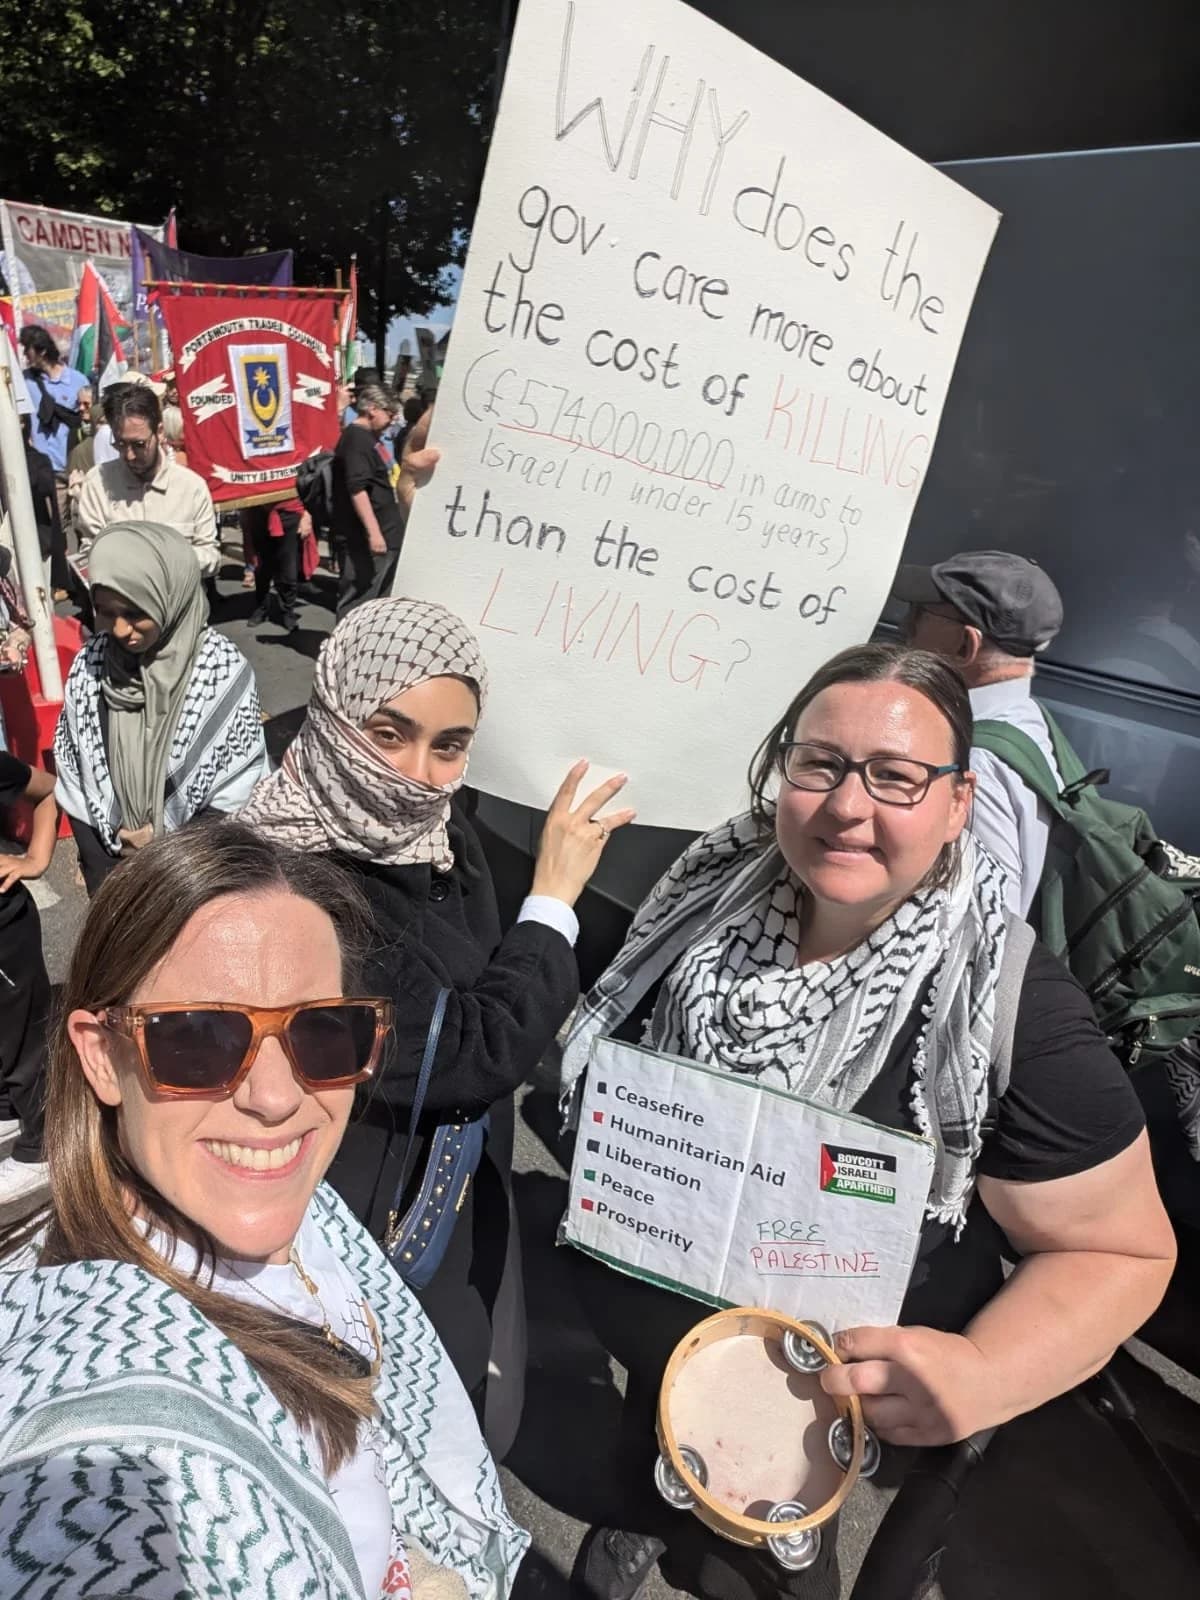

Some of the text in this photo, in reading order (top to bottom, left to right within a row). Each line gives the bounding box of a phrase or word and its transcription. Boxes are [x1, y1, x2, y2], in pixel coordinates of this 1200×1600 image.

[557, 1, 945, 334] WHY does the
[17, 216, 132, 257] CAMDEN N
[508, 185, 928, 416] gov. care more about
[185, 320, 246, 354] PORTSMOUTH
[482, 260, 931, 494] the cost of KILLING
[190, 395, 233, 406] FOUNDED
[270, 467, 298, 480] STREN
[479, 428, 851, 571] Israel in under 15 years)
[740, 473, 765, 496] in
[774, 483, 831, 519] arms
[840, 499, 863, 526] to
[444, 485, 847, 626] than the cost of
[480, 567, 752, 691] LIVING?
[615, 1084, 705, 1128] Ceasefire
[605, 1143, 702, 1192] Liberation
[610, 1114, 786, 1187] Humanitarian Aid
[837, 1153, 886, 1169] BOYCOTT
[601, 1172, 655, 1207] Peace
[836, 1179, 894, 1197] APARTHEID
[838, 1166, 878, 1180] ISRAELI
[596, 1201, 695, 1253] Prosperity
[757, 1219, 826, 1242] FREE
[750, 1246, 880, 1274] PALESTINE
